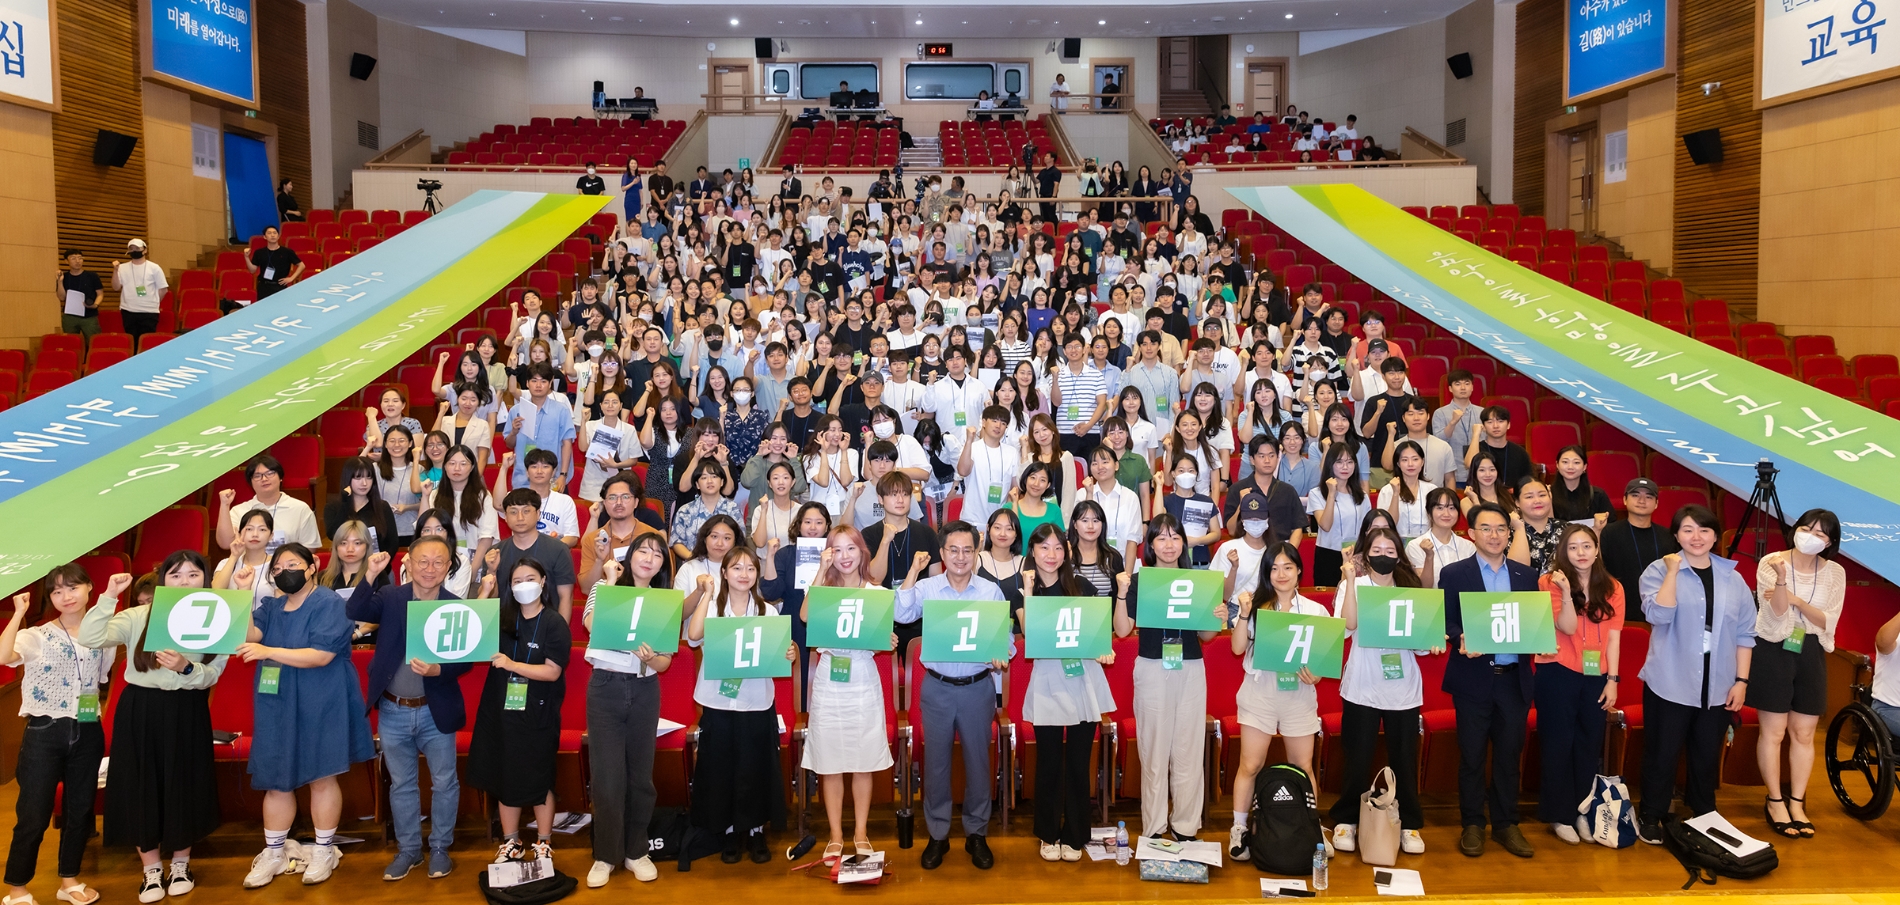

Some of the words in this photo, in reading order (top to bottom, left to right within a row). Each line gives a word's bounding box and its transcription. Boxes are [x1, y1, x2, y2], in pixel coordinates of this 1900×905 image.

[167, 6, 199, 37] 미래를
[200, 24, 241, 53] 열어갑니다.
[1579, 24, 1615, 53] 길(路)이
[1617, 9, 1653, 39] 있습니다
[1801, 0, 1887, 66] 교육
[297, 271, 386, 317] 우리의
[360, 304, 447, 351] ESG
[122, 316, 312, 399] 브랜드를
[240, 358, 375, 411] 사업가
[1533, 308, 1683, 369] 희망을
[1656, 368, 1783, 416] 주고
[1764, 408, 1896, 464] 싶어
[98, 422, 259, 495] 어때?
[541, 511, 560, 527] YORK
[180, 600, 217, 641] 그
[626, 597, 645, 642] !
[835, 599, 865, 640] 하
[1166, 580, 1194, 619] 은
[1388, 599, 1416, 637] 다
[436, 611, 469, 652] 래
[952, 610, 980, 652] 고
[1055, 607, 1082, 649] 싶
[1490, 602, 1521, 644] 해
[733, 626, 763, 669] 너
[1284, 625, 1315, 664] 거
[1273, 794, 1294, 802] adidas
